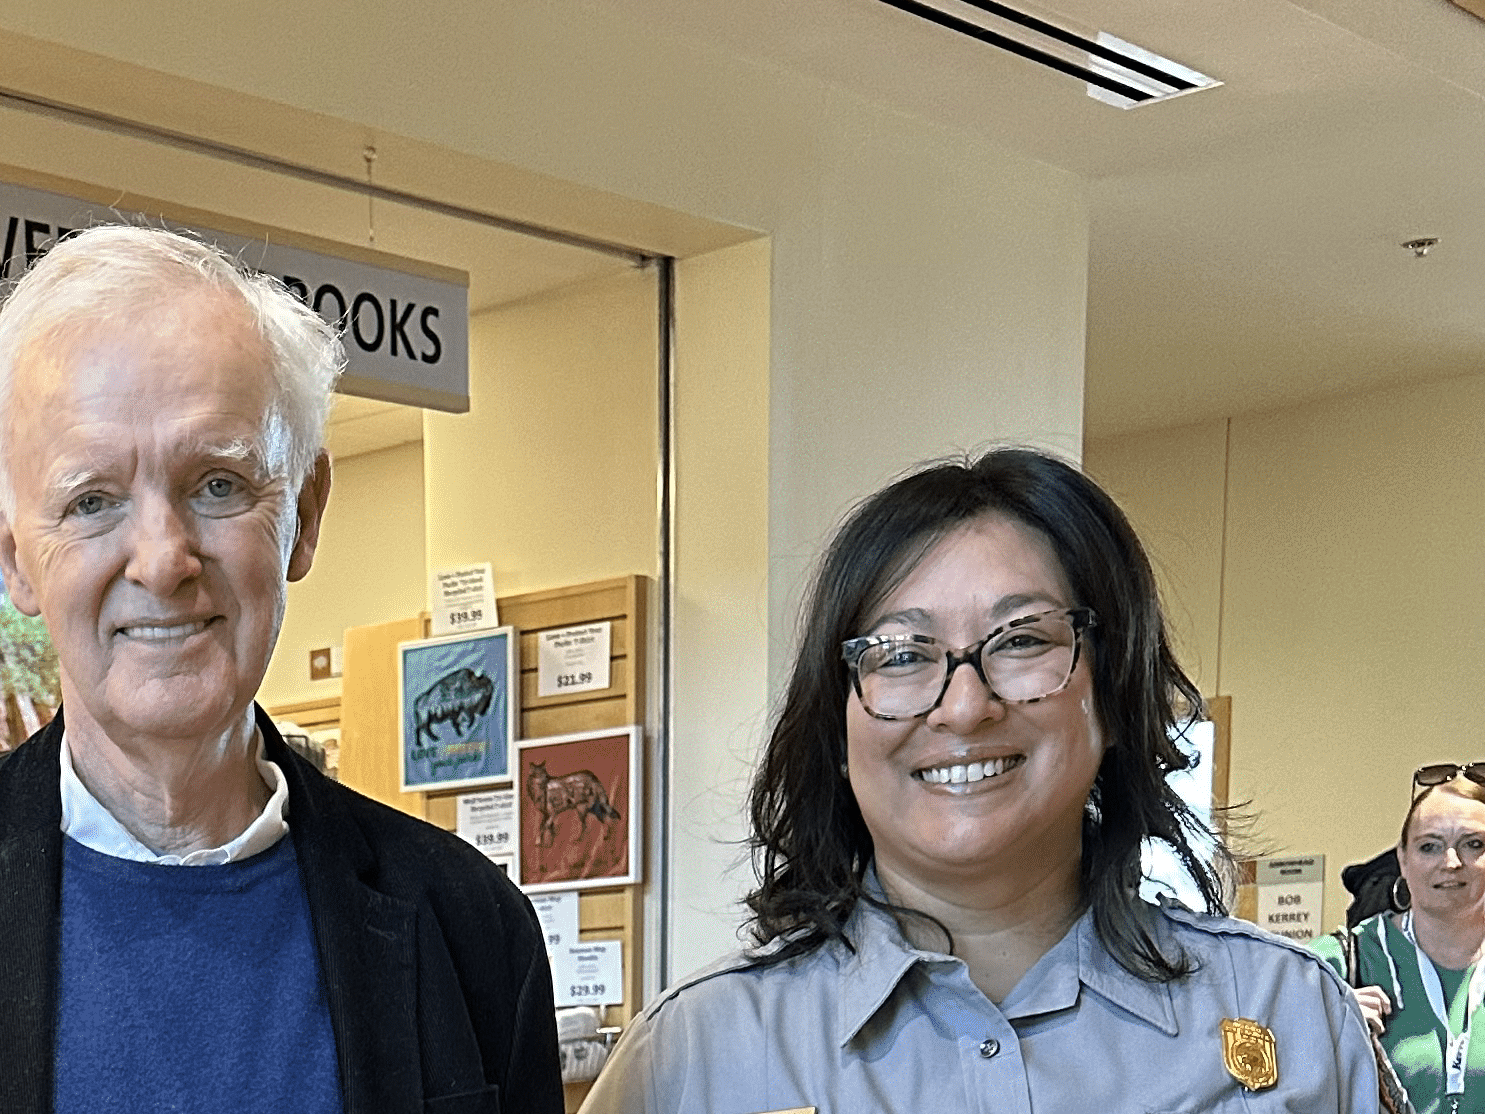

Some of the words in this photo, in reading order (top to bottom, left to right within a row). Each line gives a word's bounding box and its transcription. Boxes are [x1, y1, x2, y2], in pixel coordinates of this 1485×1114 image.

[556, 672, 593, 688] $21.99
[475, 832, 509, 847] $39.99
[1277, 894, 1301, 905] BOB
[1268, 911, 1309, 923] KERREY
[570, 984, 606, 998] $29.99
